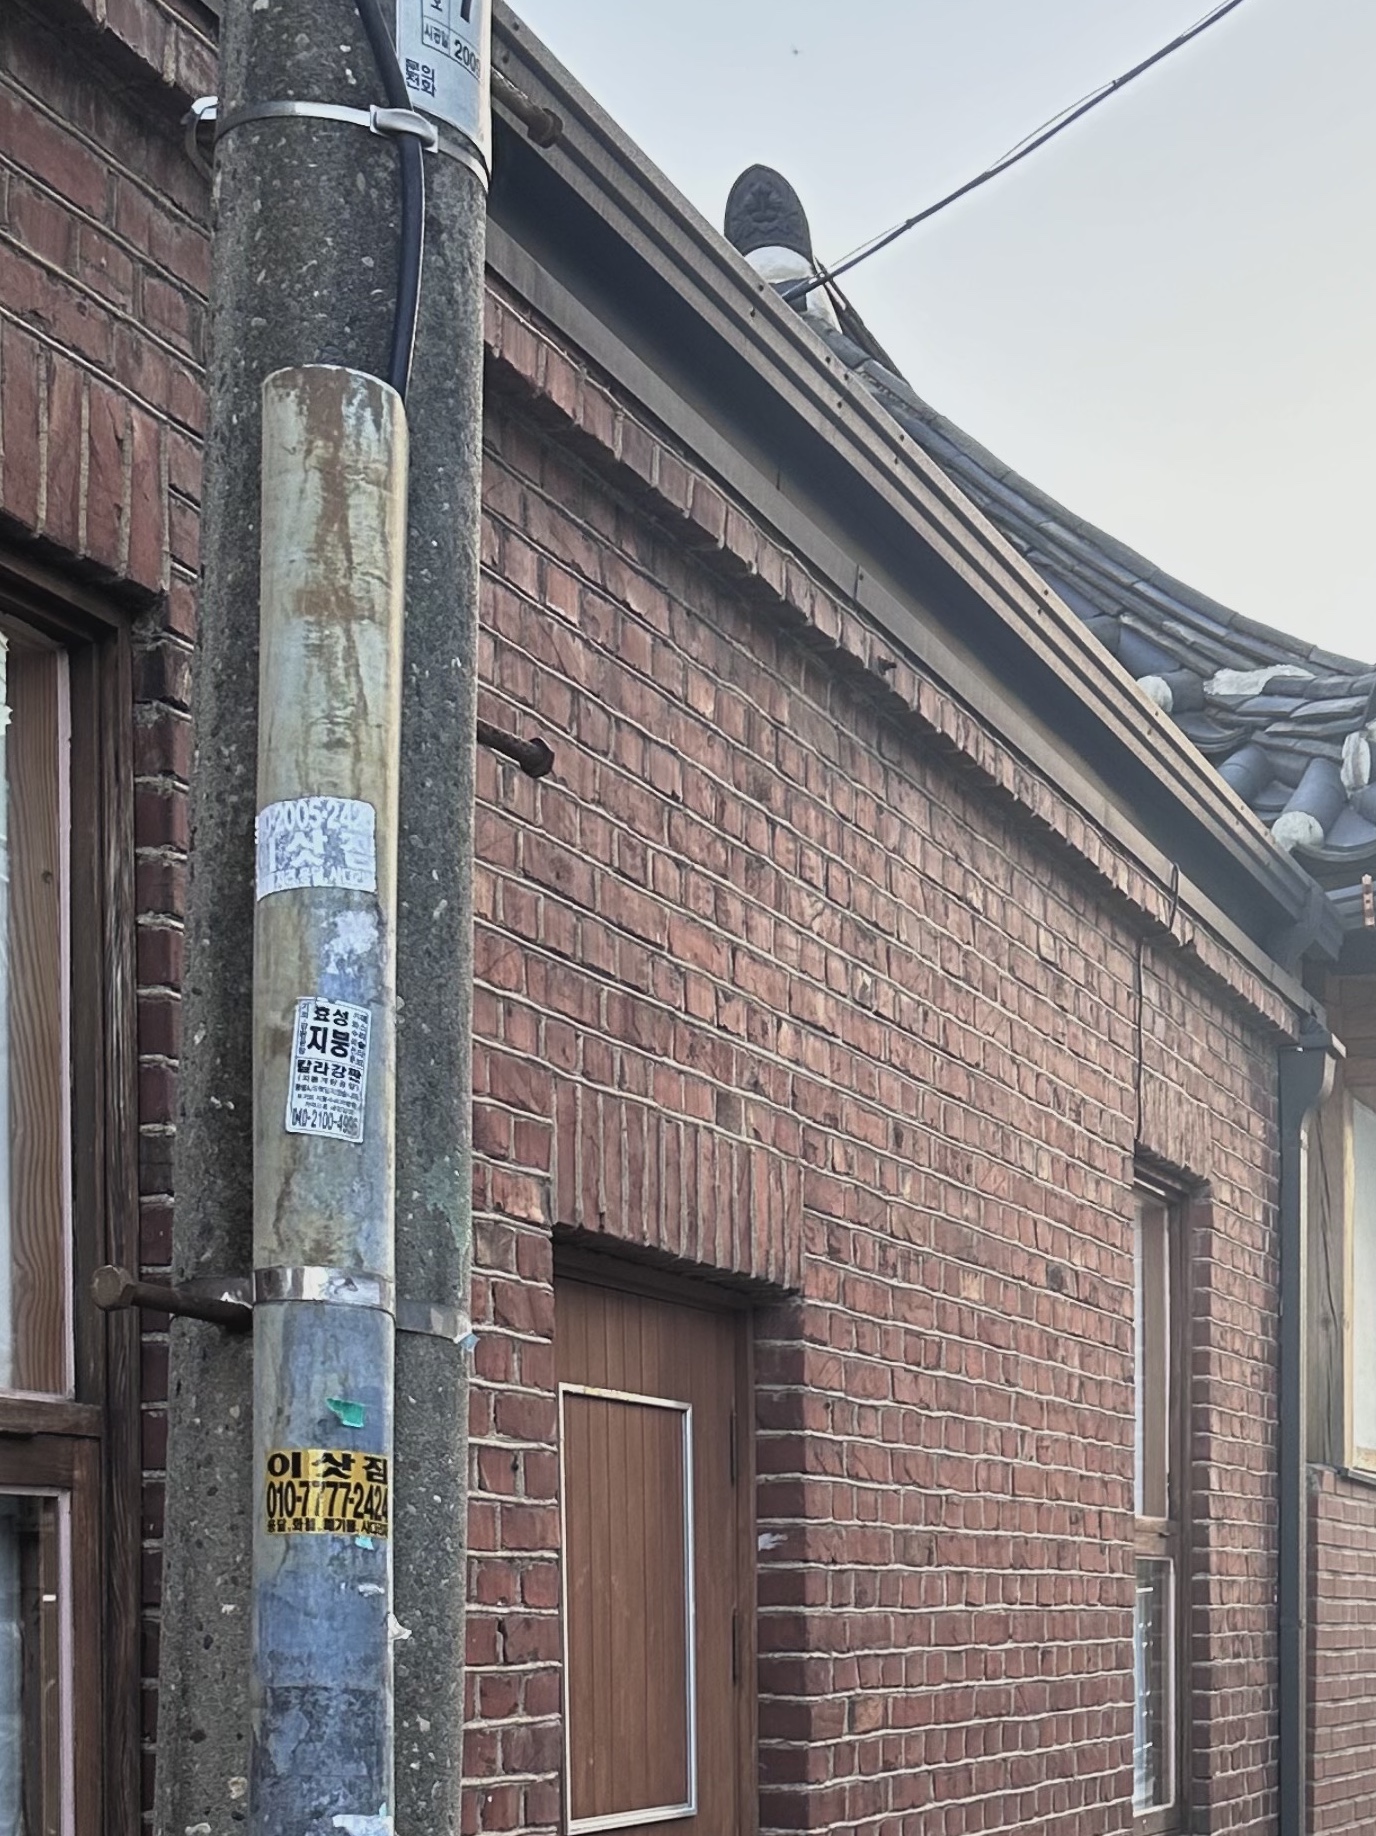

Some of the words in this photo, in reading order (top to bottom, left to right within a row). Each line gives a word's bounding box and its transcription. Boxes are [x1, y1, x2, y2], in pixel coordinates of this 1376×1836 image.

[313, 1005, 350, 1027] 효성
[307, 1025, 351, 1059] 지붕
[267, 1451, 388, 1485] 이삿짐
